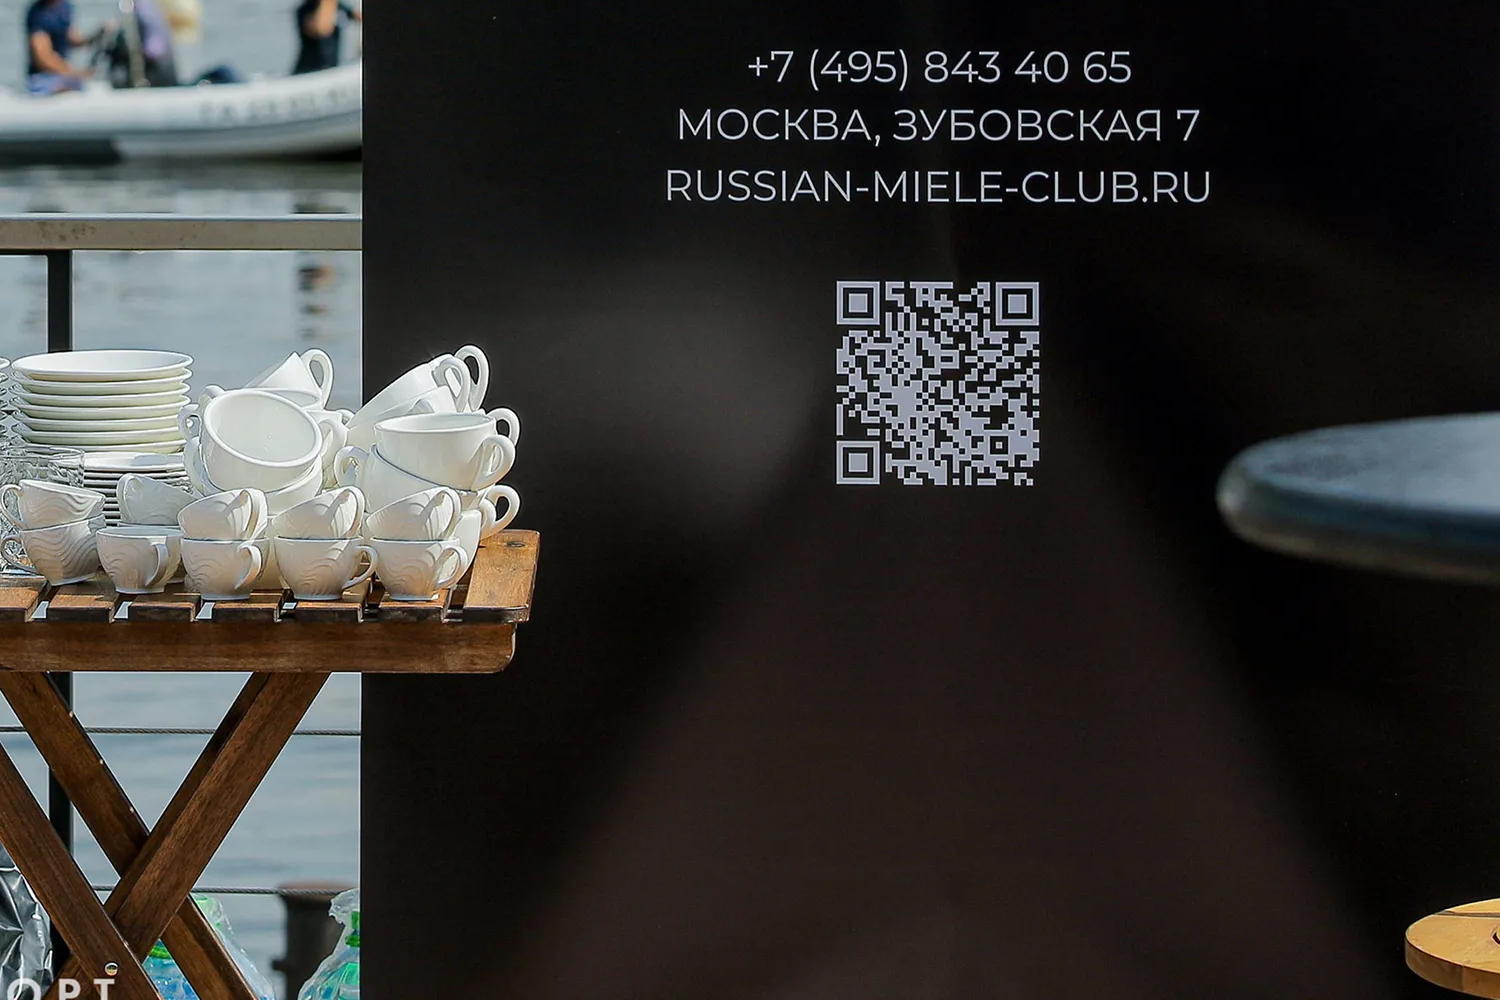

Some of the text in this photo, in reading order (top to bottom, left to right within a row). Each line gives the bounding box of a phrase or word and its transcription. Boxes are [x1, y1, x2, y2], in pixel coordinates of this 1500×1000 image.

[747, 48, 1132, 92] +7 (495) 843 40 65
[679, 108, 1200, 147] МОСКВА, ЗУБОВСКАЯ 7
[667, 169, 1210, 203] RUSSIAN-MIELE-CLUB.RU
